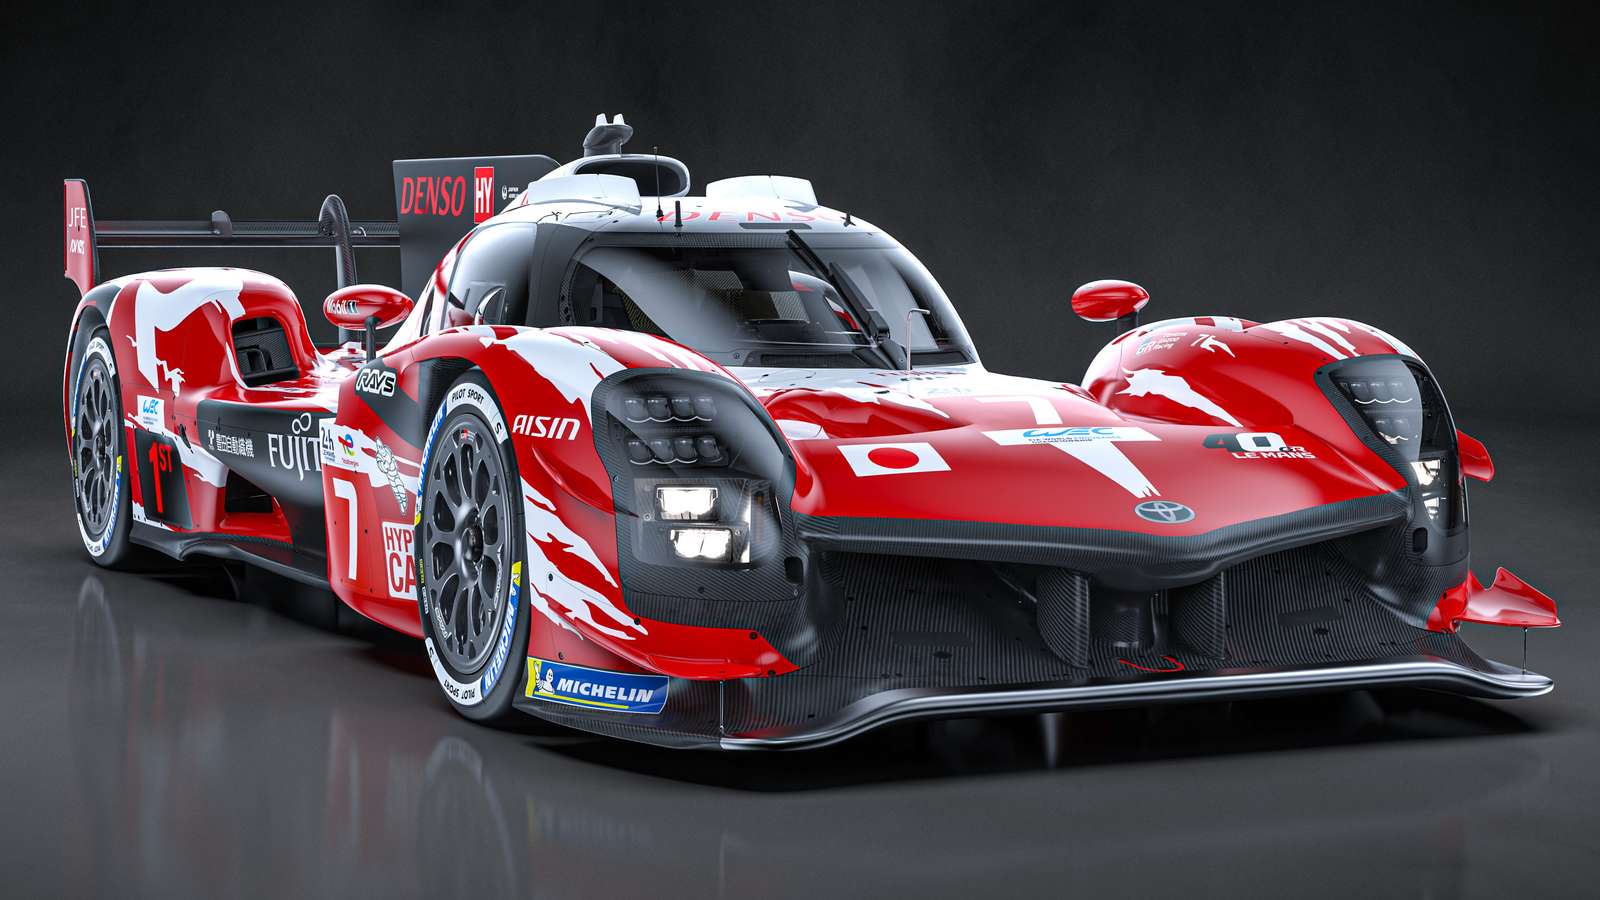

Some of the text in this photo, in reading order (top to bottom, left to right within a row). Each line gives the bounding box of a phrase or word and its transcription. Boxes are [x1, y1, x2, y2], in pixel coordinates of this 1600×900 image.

[401, 176, 493, 217] DENSO HY
[68, 207, 87, 228] JFE
[326, 297, 347, 315] Mobil
[355, 368, 397, 398] RAYS
[451, 388, 485, 404] PILOT SPORT
[143, 399, 160, 415] WEC
[512, 414, 581, 441] AISIN
[1022, 427, 1114, 438] WEC
[1202, 432, 1288, 453] 40
[148, 440, 173, 514] 1ST
[332, 477, 358, 581] 7
[384, 526, 415, 553] HYP
[484, 602, 516, 691] MICHELIN
[443, 679, 476, 701] PILOT SPORT
[556, 678, 654, 704] MICHELIN
